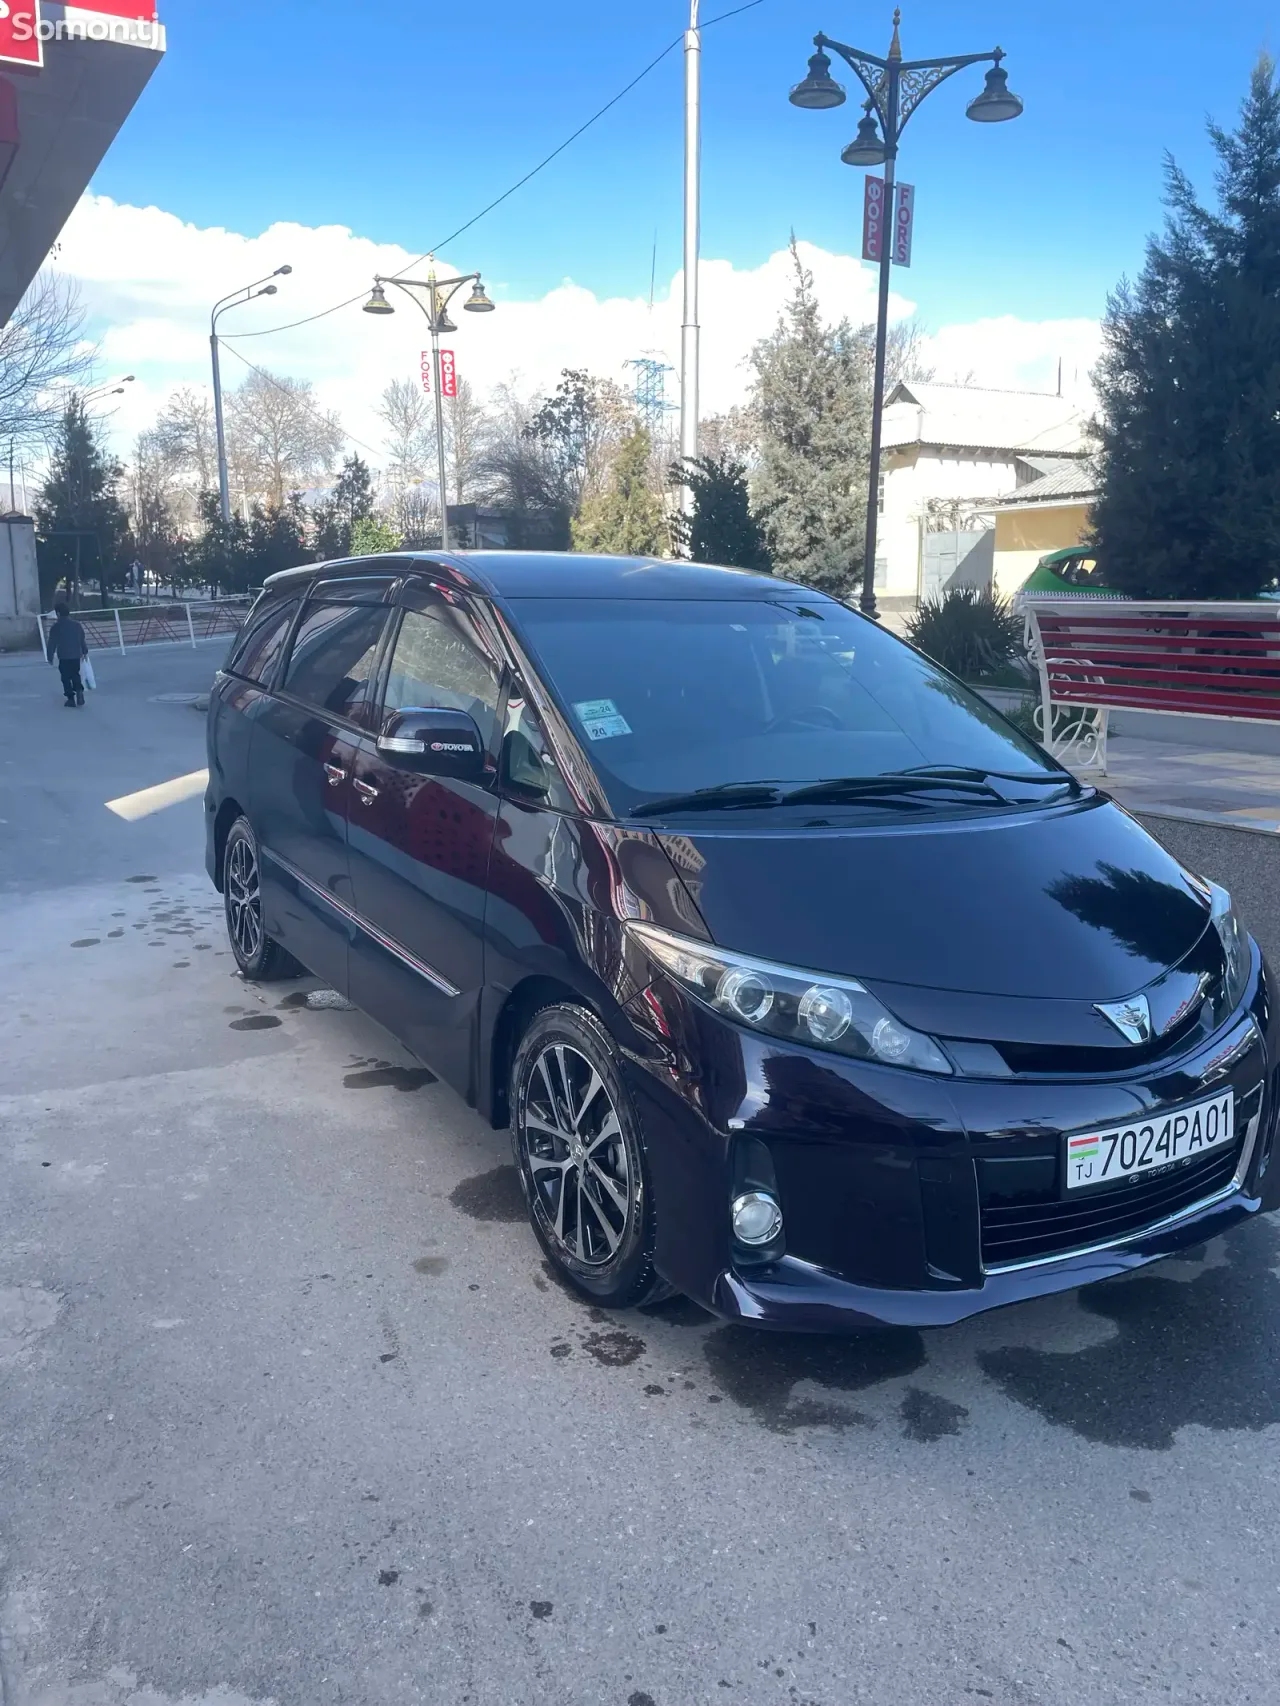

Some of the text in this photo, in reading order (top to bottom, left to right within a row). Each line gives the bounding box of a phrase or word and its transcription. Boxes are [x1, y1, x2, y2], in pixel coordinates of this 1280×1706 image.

[868, 182, 881, 257] ФОРС
[897, 187, 910, 262] FORS
[421, 351, 430, 392] FORS
[442, 352, 454, 394] ФОРС
[442, 742, 474, 752] TOYOTA
[1075, 1099, 1229, 1180] TJ 7024PA01
[1147, 1163, 1176, 1178] TOYOTA
